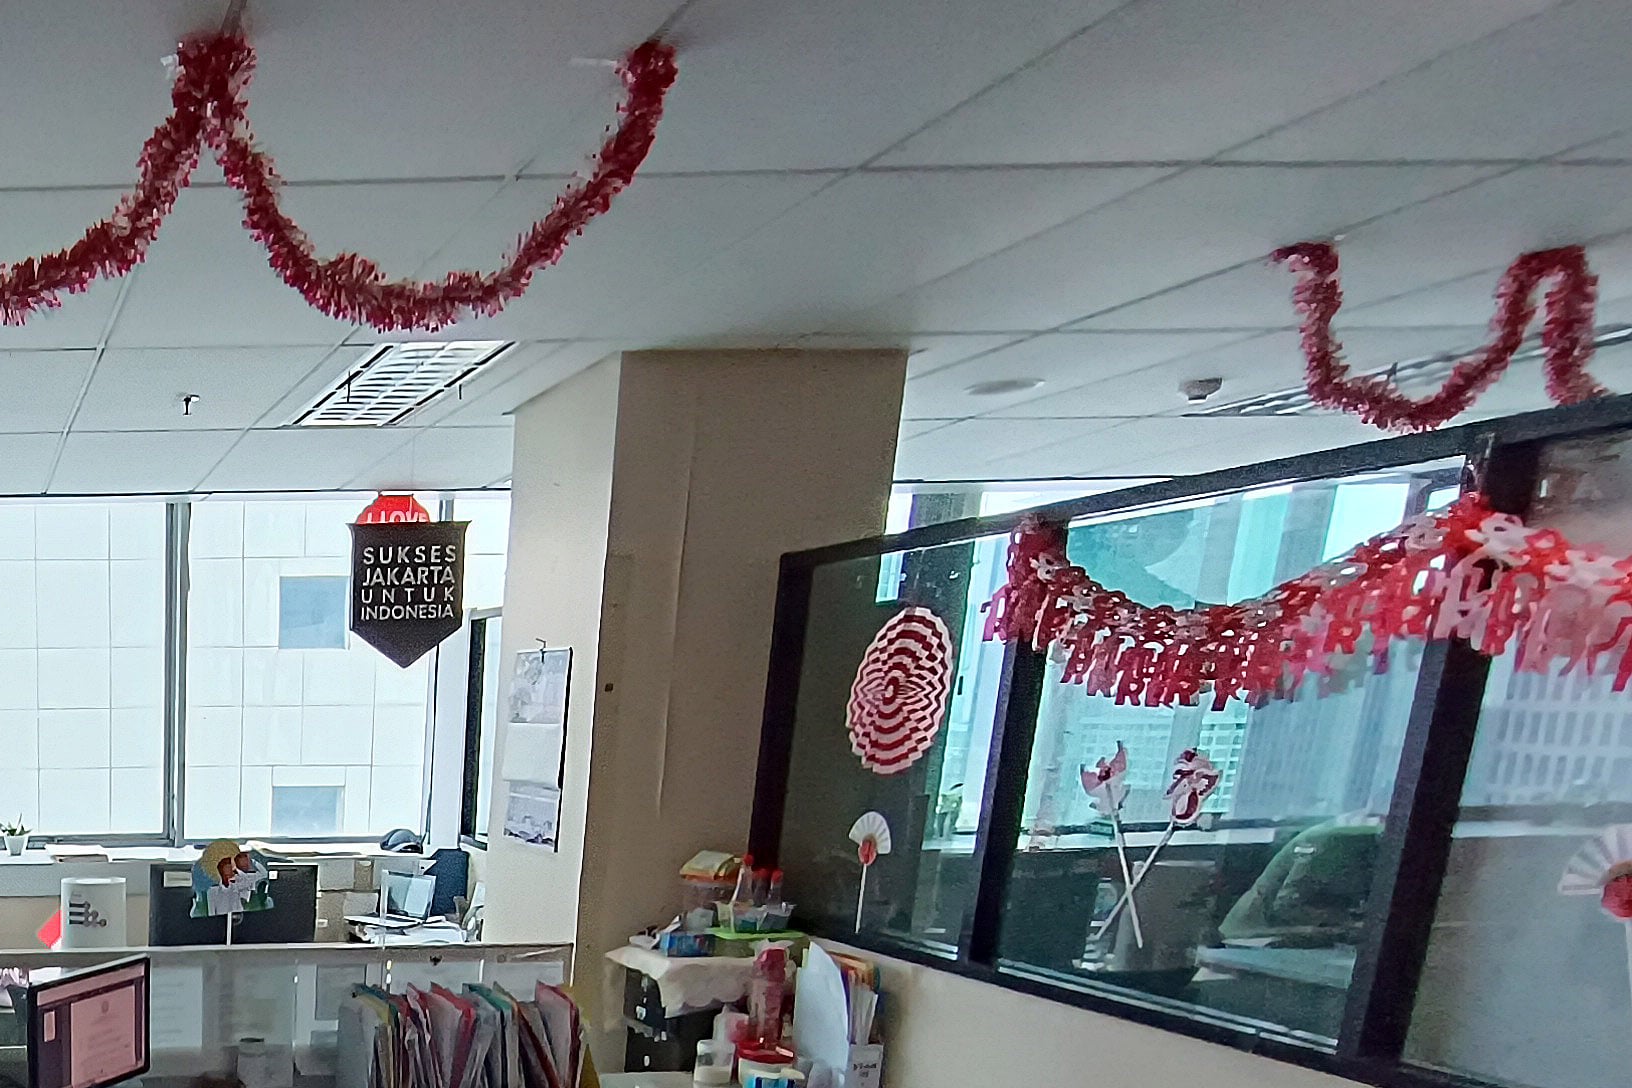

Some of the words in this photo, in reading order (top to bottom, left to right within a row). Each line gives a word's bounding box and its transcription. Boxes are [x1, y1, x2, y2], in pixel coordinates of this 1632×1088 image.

[362, 544, 457, 565] SUKSES
[361, 565, 456, 587] JAKARTA
[361, 586, 455, 604] UNTUK
[360, 603, 455, 621] INDONESIA
